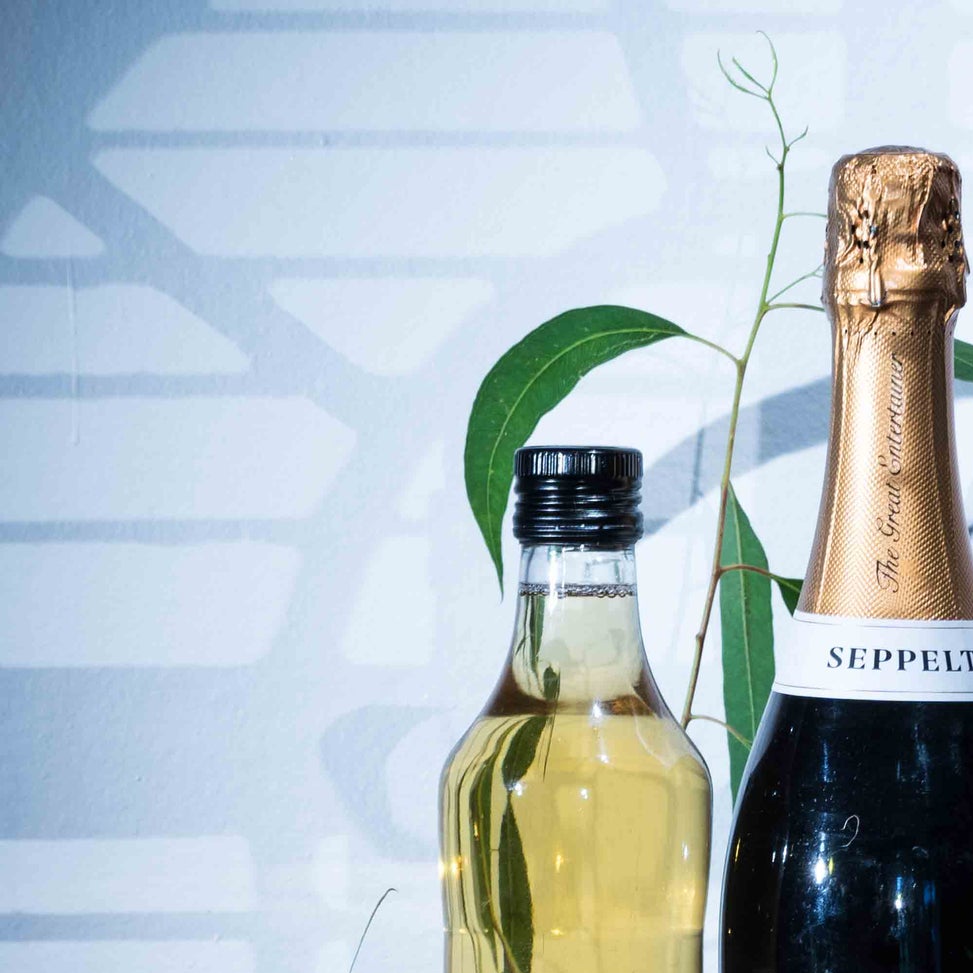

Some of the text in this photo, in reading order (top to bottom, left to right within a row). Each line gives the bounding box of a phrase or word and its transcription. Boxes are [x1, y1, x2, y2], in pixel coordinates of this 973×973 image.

[876, 352, 904, 593] The Great Entertainer
